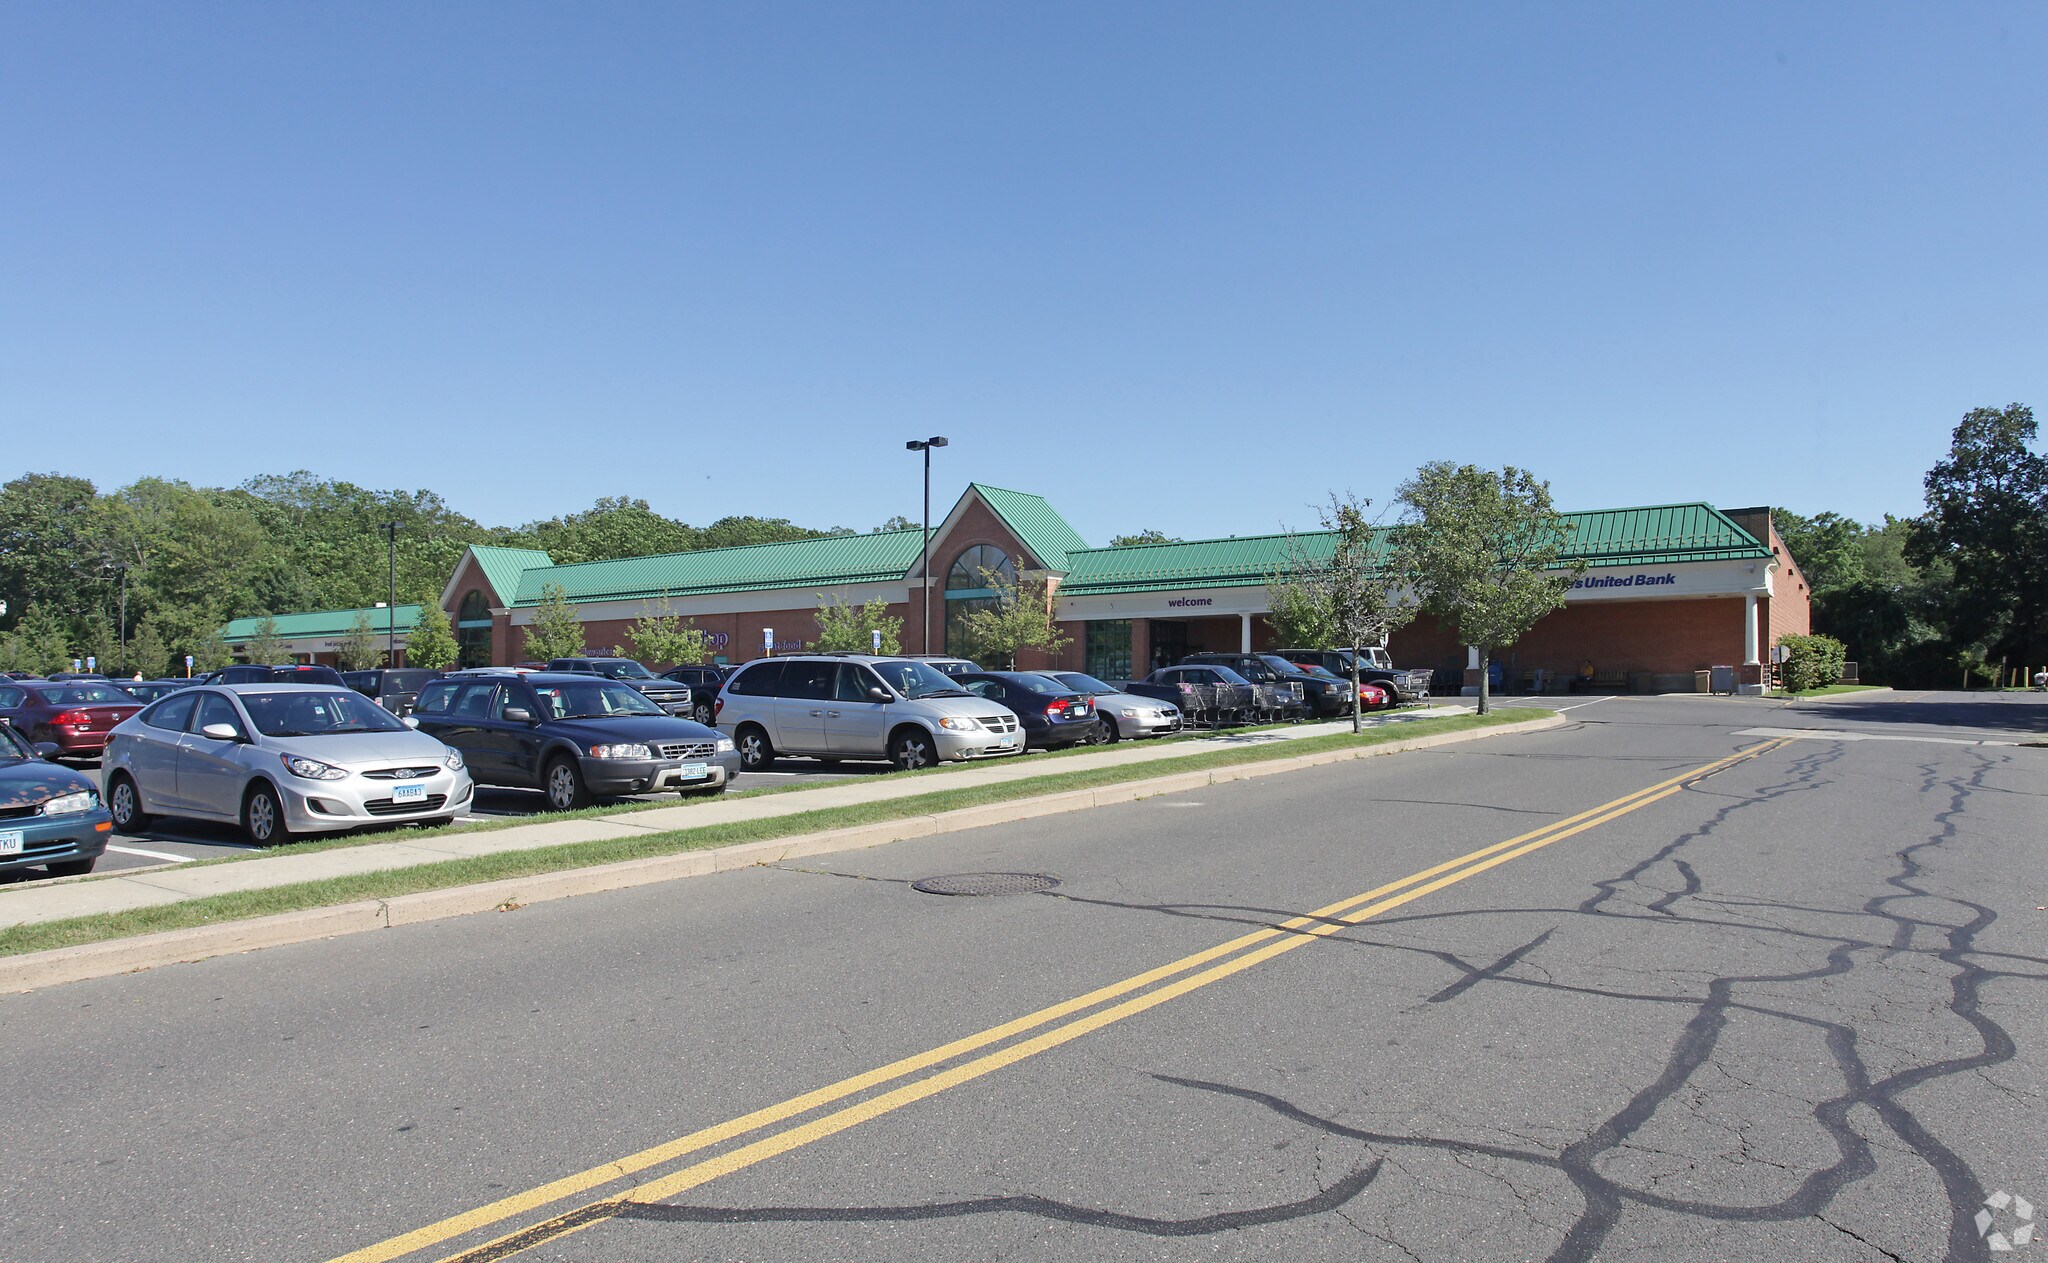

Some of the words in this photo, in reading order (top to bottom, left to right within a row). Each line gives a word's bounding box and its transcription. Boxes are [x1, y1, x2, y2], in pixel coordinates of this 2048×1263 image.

[1585, 575, 1634, 589] United
[1634, 573, 1676, 586] Bank
[1168, 597, 1213, 607] welcome
[700, 629, 729, 651] hop
[781, 640, 802, 650] food
